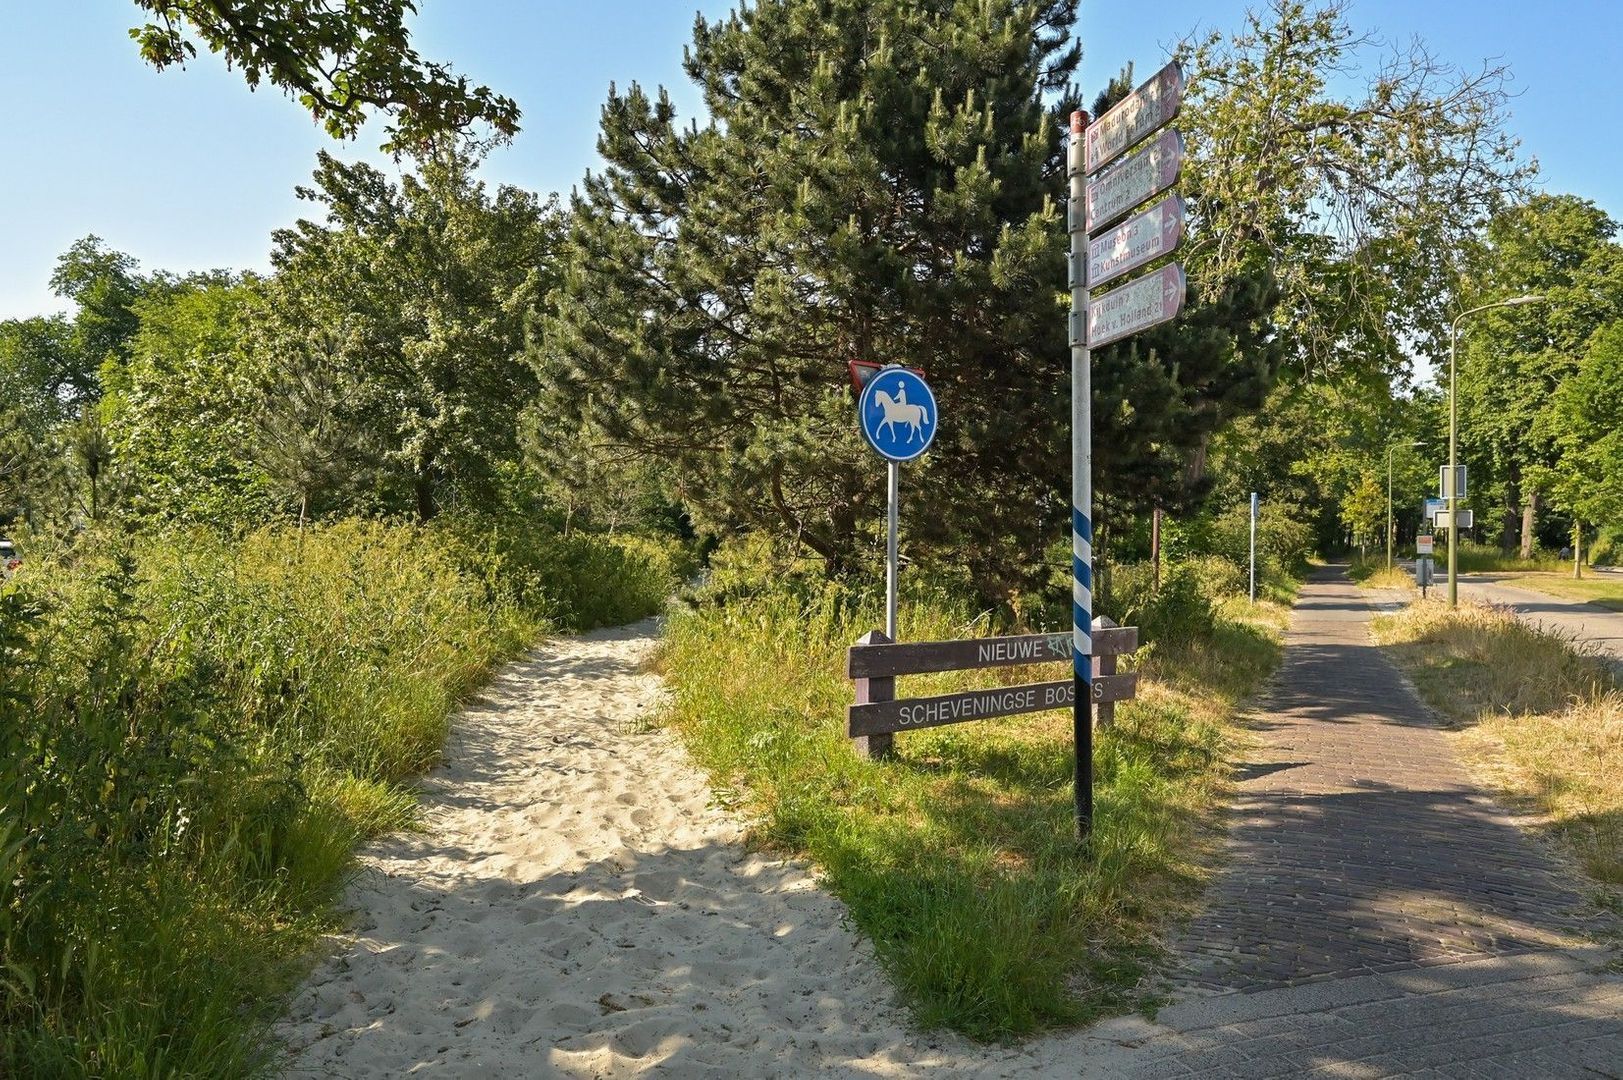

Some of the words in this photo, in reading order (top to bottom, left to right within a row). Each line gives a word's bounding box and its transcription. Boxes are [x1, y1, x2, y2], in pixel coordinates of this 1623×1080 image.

[1100, 131, 1122, 154] World
[1091, 193, 1123, 220] Centrum
[1100, 229, 1131, 252] Museon
[1100, 236, 1159, 273] Kunstmuseum
[1091, 321, 1110, 338] Hoek
[1120, 302, 1151, 326] Holland
[978, 640, 1043, 662] NIEUWE
[899, 690, 1035, 726] SCHEVENINGSE
[1045, 682, 1104, 706] BOSS
